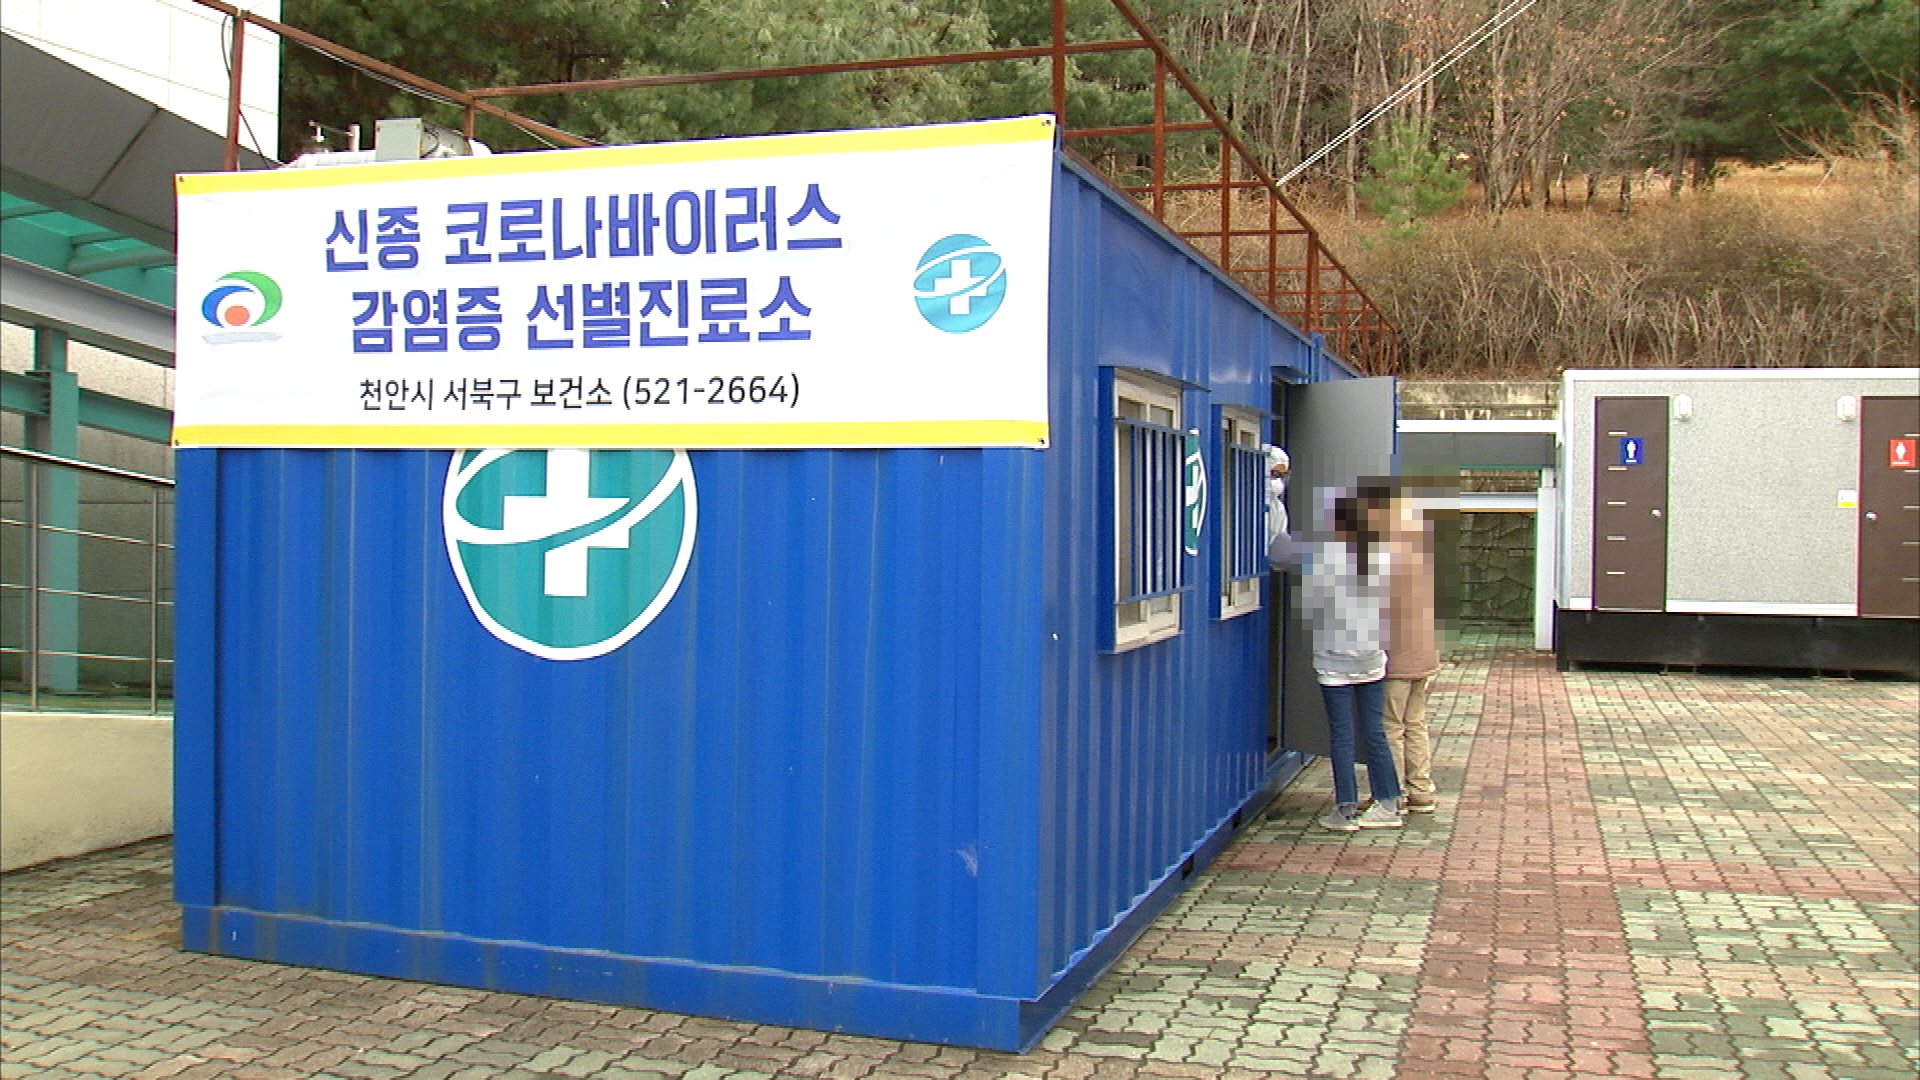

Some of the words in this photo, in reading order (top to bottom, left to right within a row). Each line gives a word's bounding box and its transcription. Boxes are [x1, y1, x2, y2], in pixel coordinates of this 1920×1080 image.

[326, 206, 421, 273] 신종
[445, 183, 843, 265] 코로나바이러스
[352, 287, 503, 353] 감염증
[526, 275, 812, 350] 선별진료소
[360, 377, 434, 411] 천안시
[443, 377, 522, 411] 서북구
[530, 376, 613, 409] 보건소
[623, 373, 800, 411] (521-2664)
